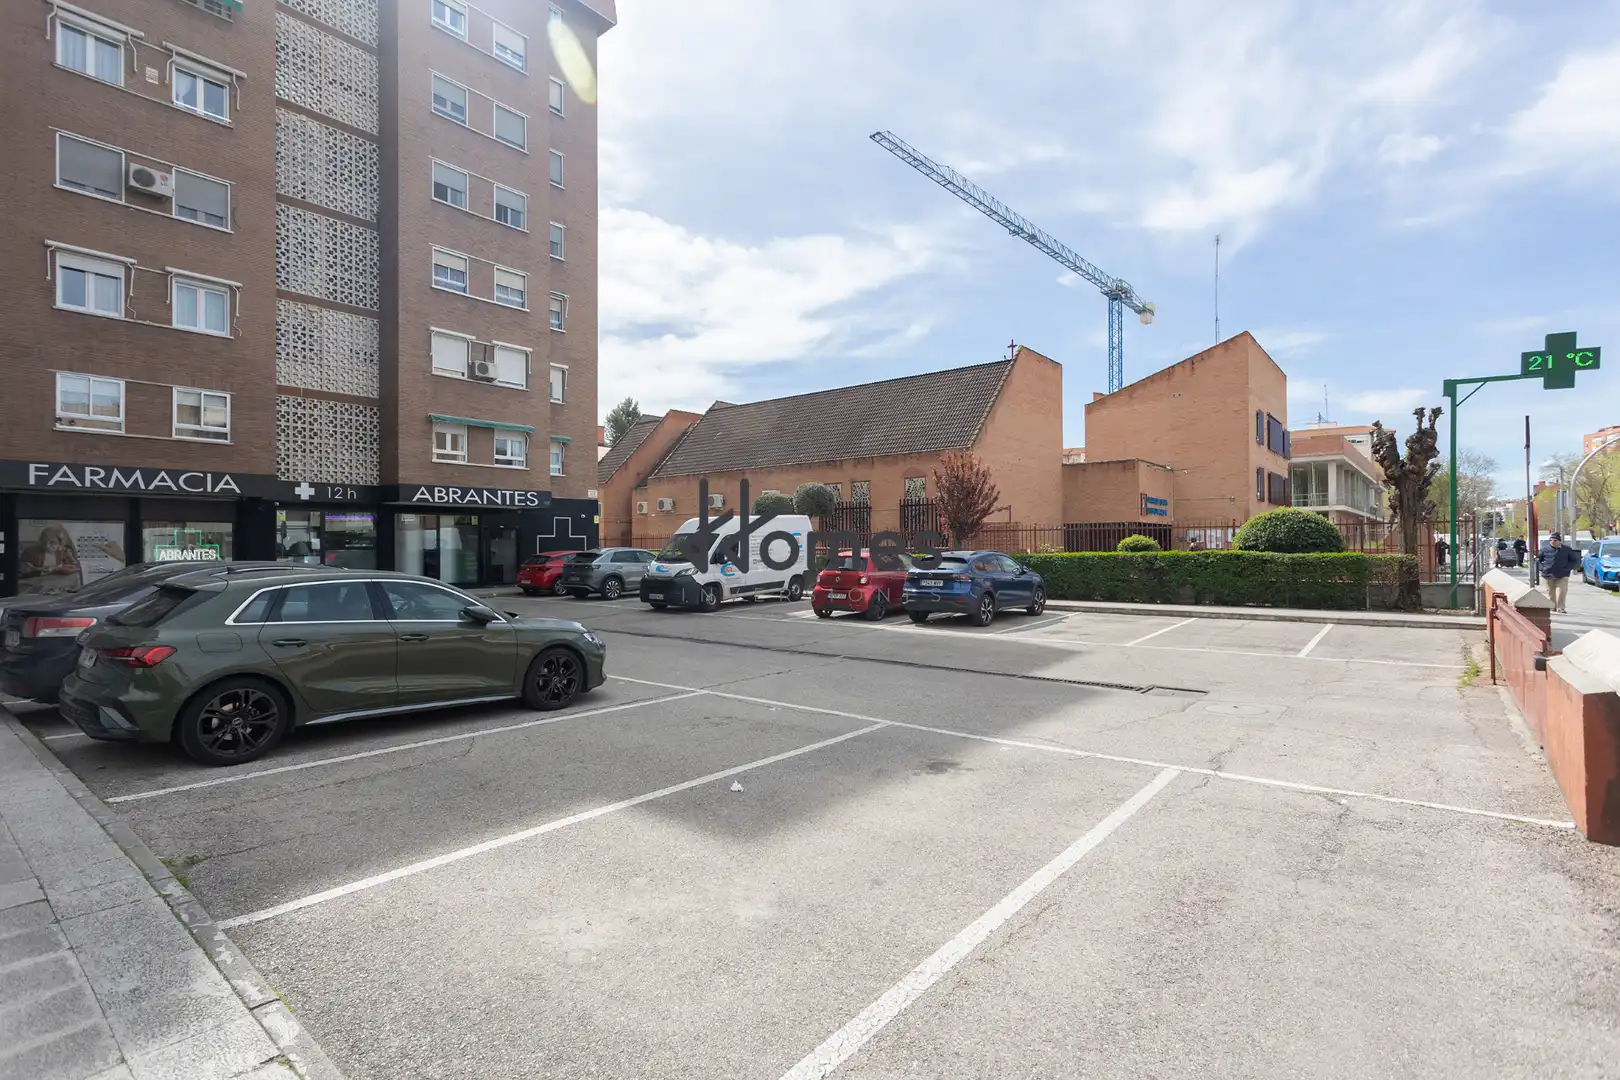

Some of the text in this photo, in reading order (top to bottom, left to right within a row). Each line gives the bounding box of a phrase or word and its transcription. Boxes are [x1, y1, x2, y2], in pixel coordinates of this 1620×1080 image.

[1528, 351, 1594, 371] 21 °C
[29, 464, 241, 493] FARMACIA
[327, 486, 357, 499] 12 h
[412, 486, 539, 507] ABRANTES
[159, 548, 216, 561] ABRANTES
